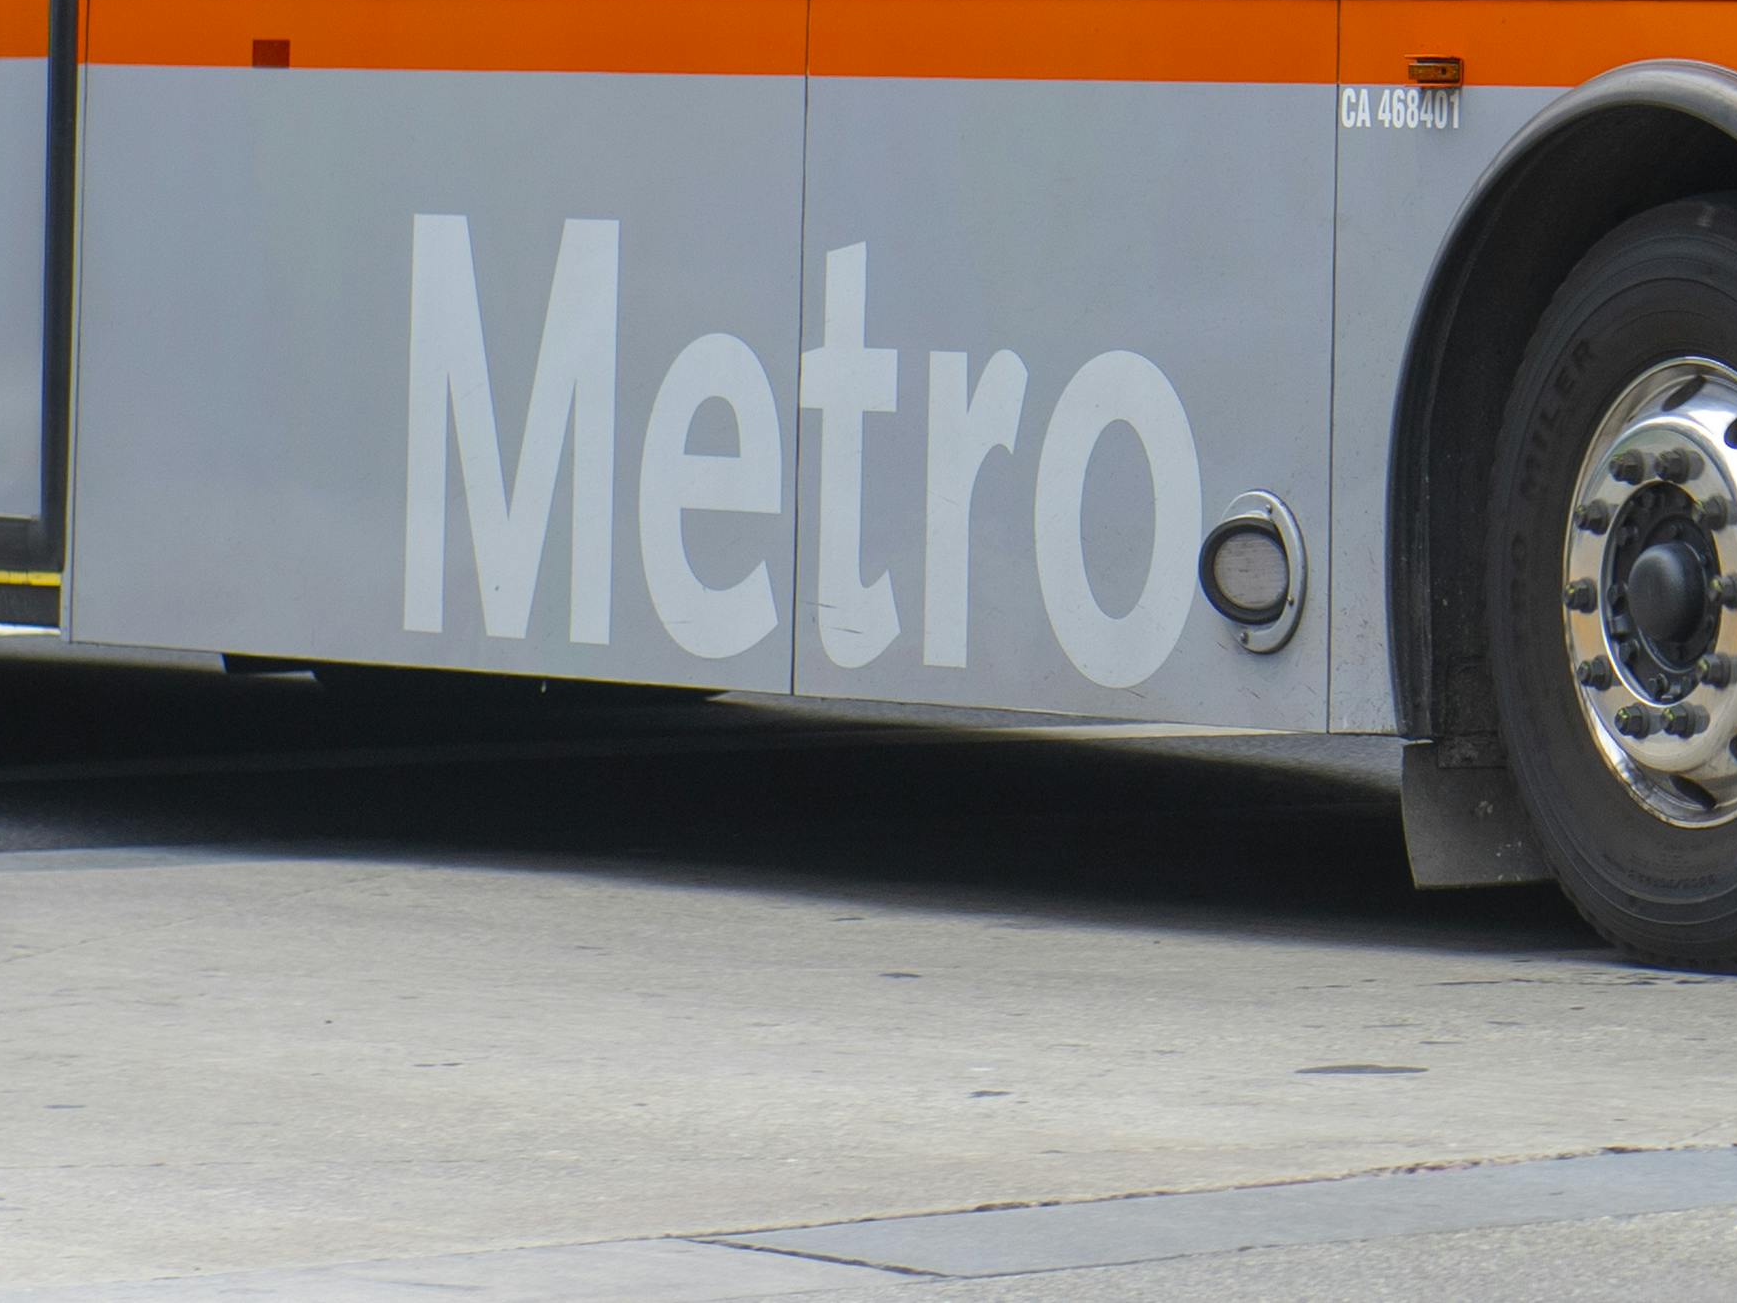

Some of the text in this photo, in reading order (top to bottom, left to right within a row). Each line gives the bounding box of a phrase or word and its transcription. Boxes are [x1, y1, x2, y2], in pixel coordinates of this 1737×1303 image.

[1341, 87, 1460, 129] CA 468401
[402, 212, 1204, 690] Metro
